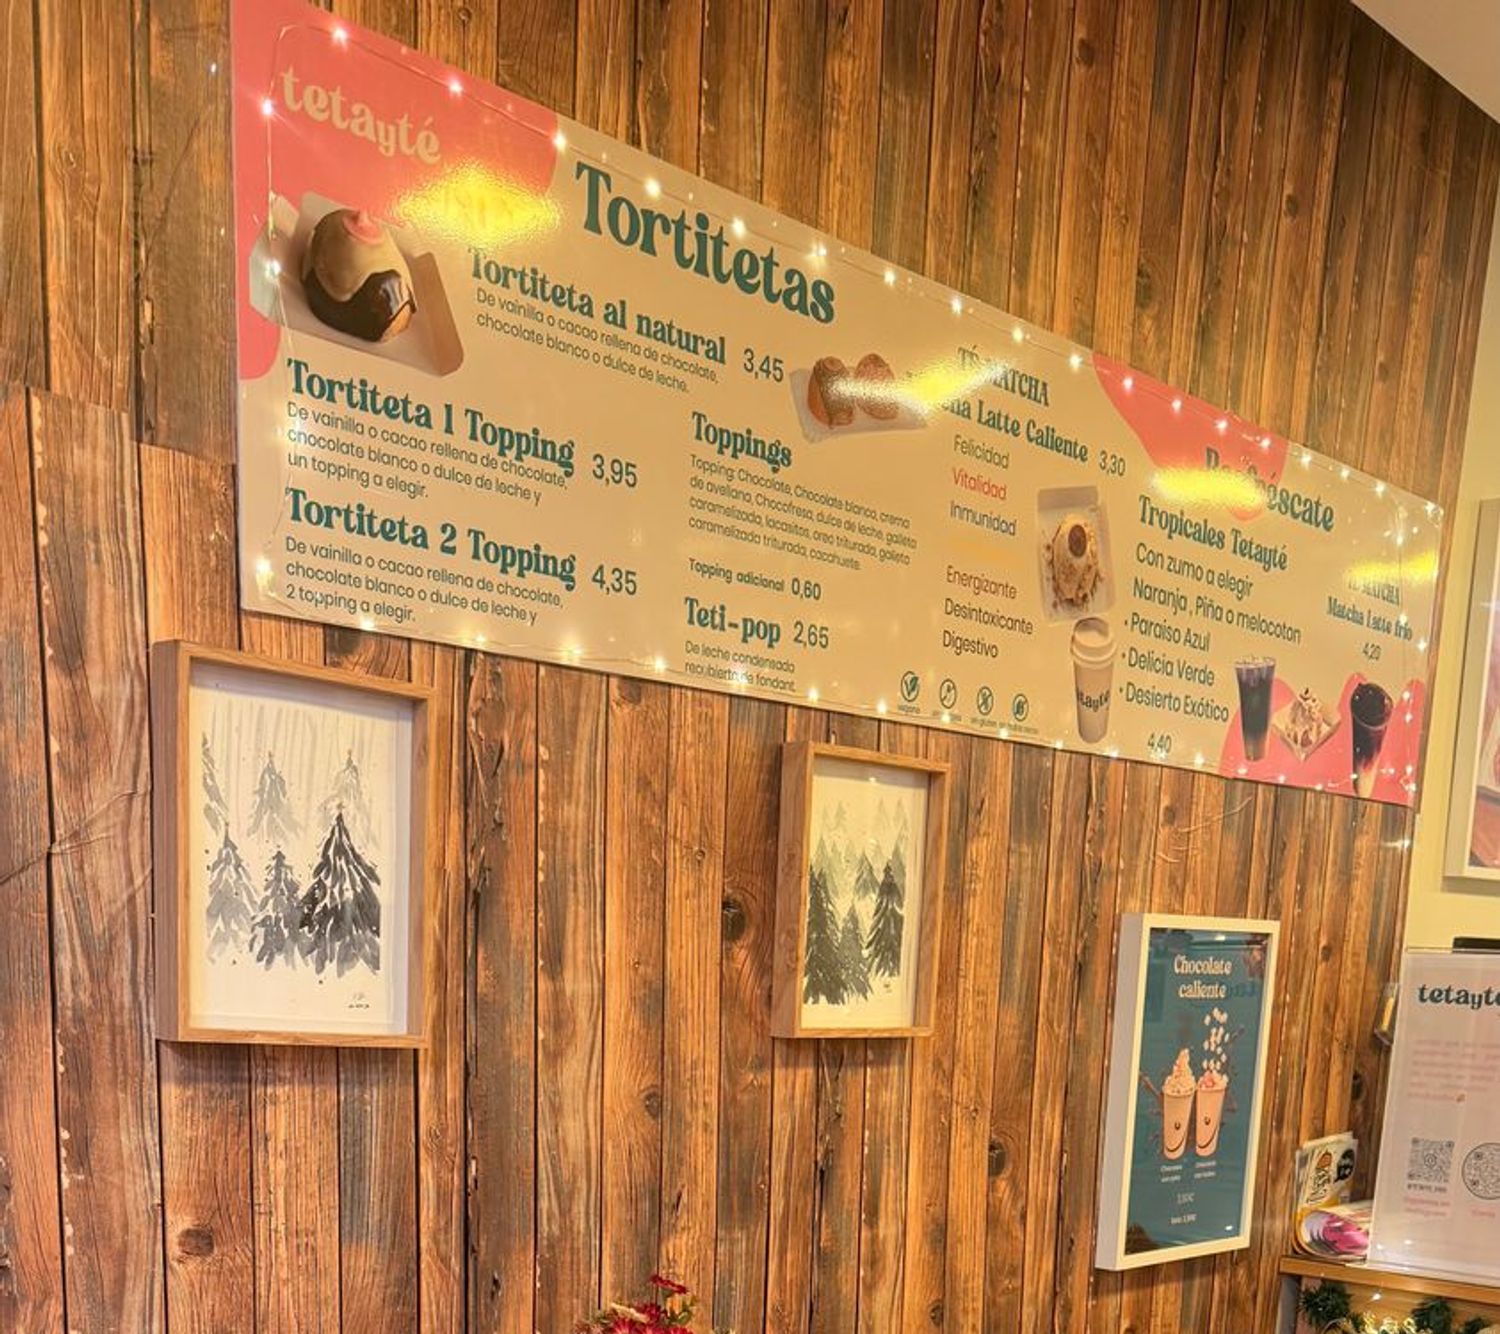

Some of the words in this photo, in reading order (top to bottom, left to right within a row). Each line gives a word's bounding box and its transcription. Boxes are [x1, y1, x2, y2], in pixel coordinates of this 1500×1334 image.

[280, 65, 441, 164] tetayté
[575, 161, 834, 324] Tortitetas
[470, 247, 594, 318] Tortiteta
[603, 300, 627, 330] al
[637, 313, 726, 364] natural
[743, 348, 784, 383] 3,45
[476, 288, 496, 306] De
[498, 296, 544, 323] vainilla
[547, 314, 555, 327] o
[558, 317, 598, 342] cacao
[600, 331, 641, 356] rellena
[643, 344, 658, 362] de
[476, 312, 544, 345] chocolate
[547, 333, 589, 361] blanco
[592, 351, 600, 364] o
[603, 352, 636, 377] dulce
[639, 364, 653, 382] de
[287, 358, 433, 429] Tortiteta
[444, 403, 454, 435] 1
[464, 408, 575, 478] Topping
[592, 453, 637, 488] 3,95
[287, 401, 309, 420] De
[312, 408, 365, 436] vainilla
[368, 426, 378, 439] o
[381, 431, 427, 452] cacao
[430, 442, 478, 465] rellena
[480, 453, 498, 470] de
[501, 458, 568, 490] chocolate,
[692, 411, 793, 474] Toppings
[977, 399, 1020, 437] Latte
[1026, 419, 1088, 463] Caliente
[1099, 450, 1126, 477] 3,30
[287, 427, 365, 459] chocolate
[367, 448, 418, 472] blanco
[421, 462, 430, 475] o
[433, 462, 472, 486] dulce
[475, 474, 493, 491] de
[495, 477, 531, 501] leche
[533, 490, 542, 507] y
[953, 434, 1010, 470] Felicidad
[287, 453, 308, 469] un
[311, 457, 370, 489] topping
[373, 474, 383, 487] a
[386, 476, 429, 500] elegir.
[952, 467, 1007, 501] Vitalidad
[690, 476, 704, 489] de
[816, 510, 842, 528] dulce
[844, 520, 857, 533] de
[886, 531, 918, 549] galleta
[794, 484, 843, 510] Chocolate
[880, 512, 910, 529] crema
[950, 500, 1017, 537] Inmunidad
[285, 487, 429, 549] Tortiteta
[440, 522, 457, 555] 2
[467, 528, 576, 592] Topping
[592, 564, 637, 596] 4,35
[688, 516, 761, 545] caramelizada
[1138, 494, 1226, 550] Tropicales
[1230, 528, 1288, 573] Tetayté
[285, 536, 307, 554] De
[309, 543, 362, 566] vainilla
[365, 556, 375, 568] o
[378, 558, 424, 578] cacao
[427, 568, 473, 588] rellena
[476, 576, 494, 592] de
[497, 581, 564, 609] chocolate,
[688, 557, 733, 584] Topping
[736, 571, 785, 592] adicional
[791, 577, 822, 601] 0,60
[878, 548, 910, 566] galleta
[1136, 542, 1164, 570] Con
[1167, 555, 1204, 582] zumo
[1206, 568, 1215, 586] a
[1217, 571, 1254, 601] elegir
[286, 561, 362, 589] chocolate
[365, 575, 414, 599] blanco
[418, 589, 427, 600] o
[430, 589, 469, 608] dulce
[471, 597, 489, 613] de
[491, 602, 527, 621] leche
[528, 610, 537, 626] y
[286, 584, 295, 599] 2
[299, 586, 357, 615] topping
[360, 601, 370, 612] a
[374, 602, 416, 624] elegir.
[946, 564, 1017, 600] Energizante
[684, 596, 781, 649] Teti-pop
[793, 621, 829, 649] 2,65
[944, 597, 1034, 636] Desintoxicante
[1133, 576, 1188, 616] Naranja
[1195, 595, 1224, 622] Piña
[1226, 609, 1235, 624] o
[1236, 611, 1301, 644] melocoton
[1327, 596, 1364, 626] Matcha
[1367, 608, 1392, 634] Latte
[685, 640, 700, 654] De
[701, 641, 730, 662] leche
[732, 651, 795, 673] condensada
[942, 629, 999, 659] Digestivo
[1184, 628, 1211, 652] Azul
[1128, 647, 1173, 676] Delicia
[1177, 658, 1215, 687] Verde
[1126, 681, 1181, 713] Desierto
[1184, 695, 1229, 723] Exótico
[1174, 954, 1233, 975] Chocolate
[1179, 980, 1227, 1000] caliente
